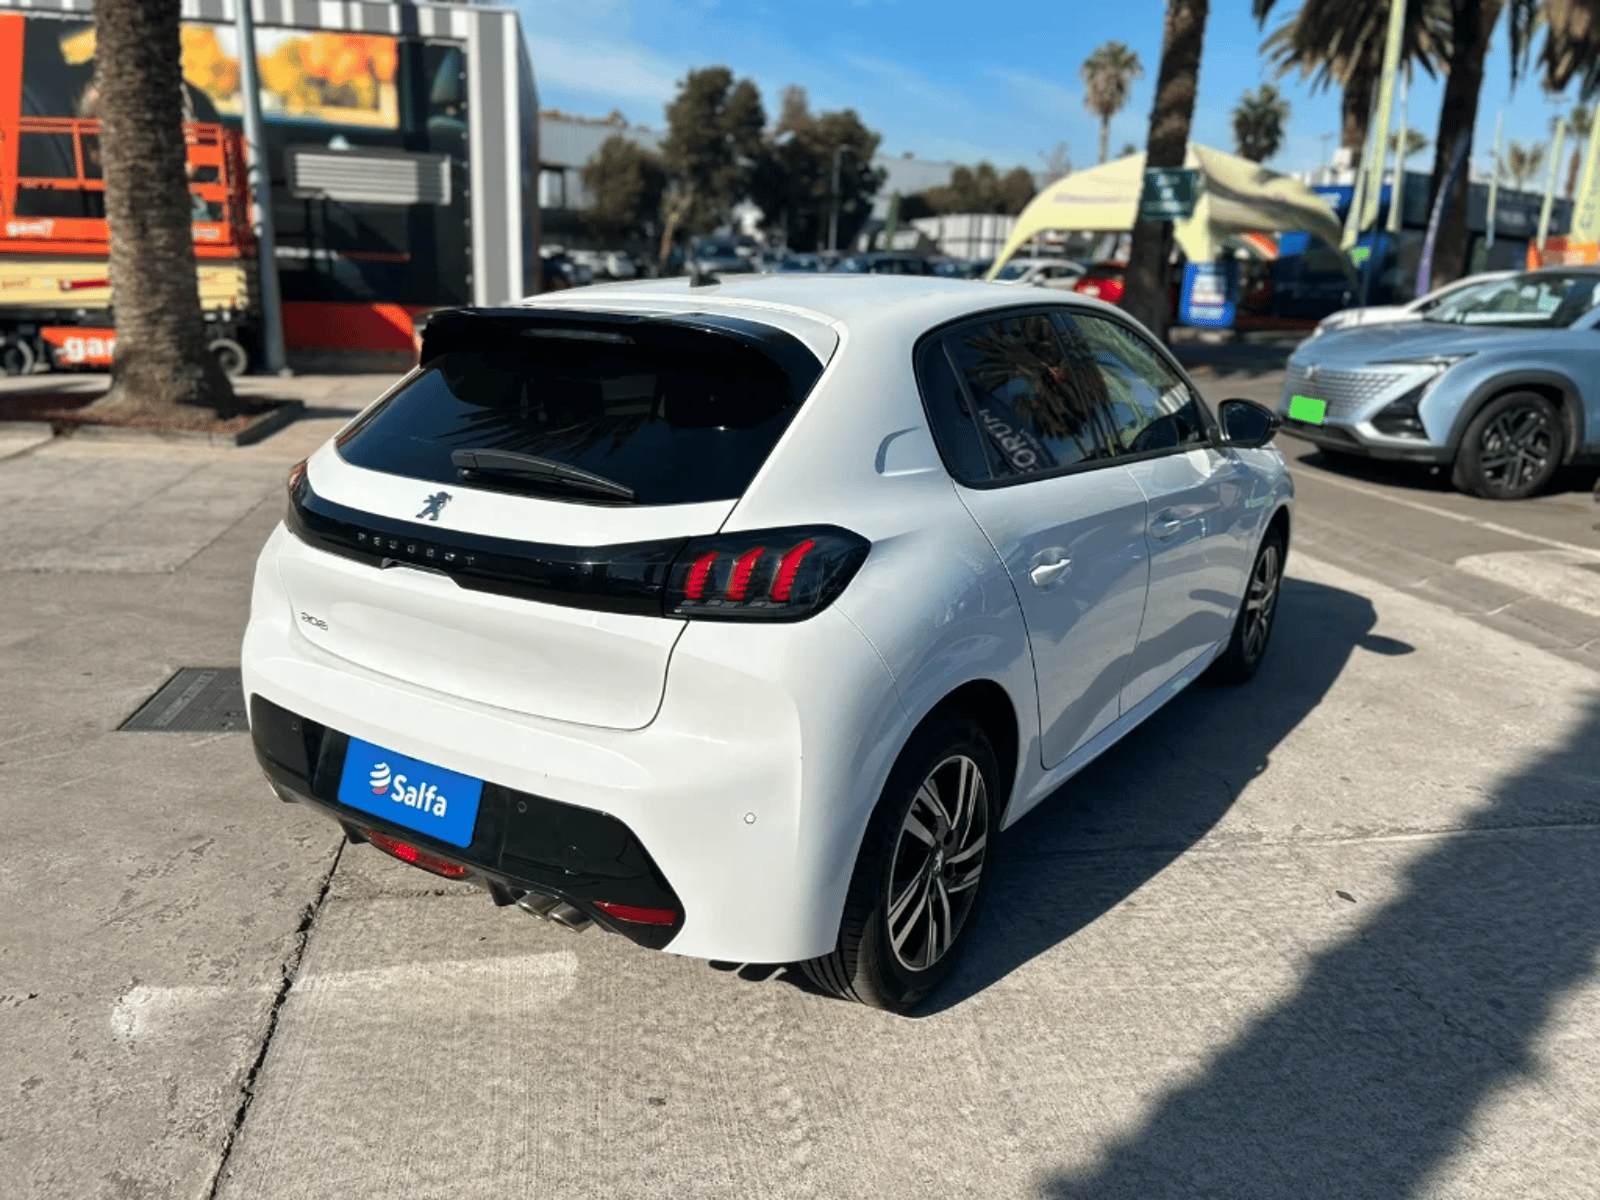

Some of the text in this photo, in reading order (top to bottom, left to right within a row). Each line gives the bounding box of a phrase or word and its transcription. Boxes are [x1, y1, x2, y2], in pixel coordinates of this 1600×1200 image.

[358, 532, 475, 565] PEUGEOT
[301, 611, 329, 631] 208
[390, 774, 448, 818] Salfa
